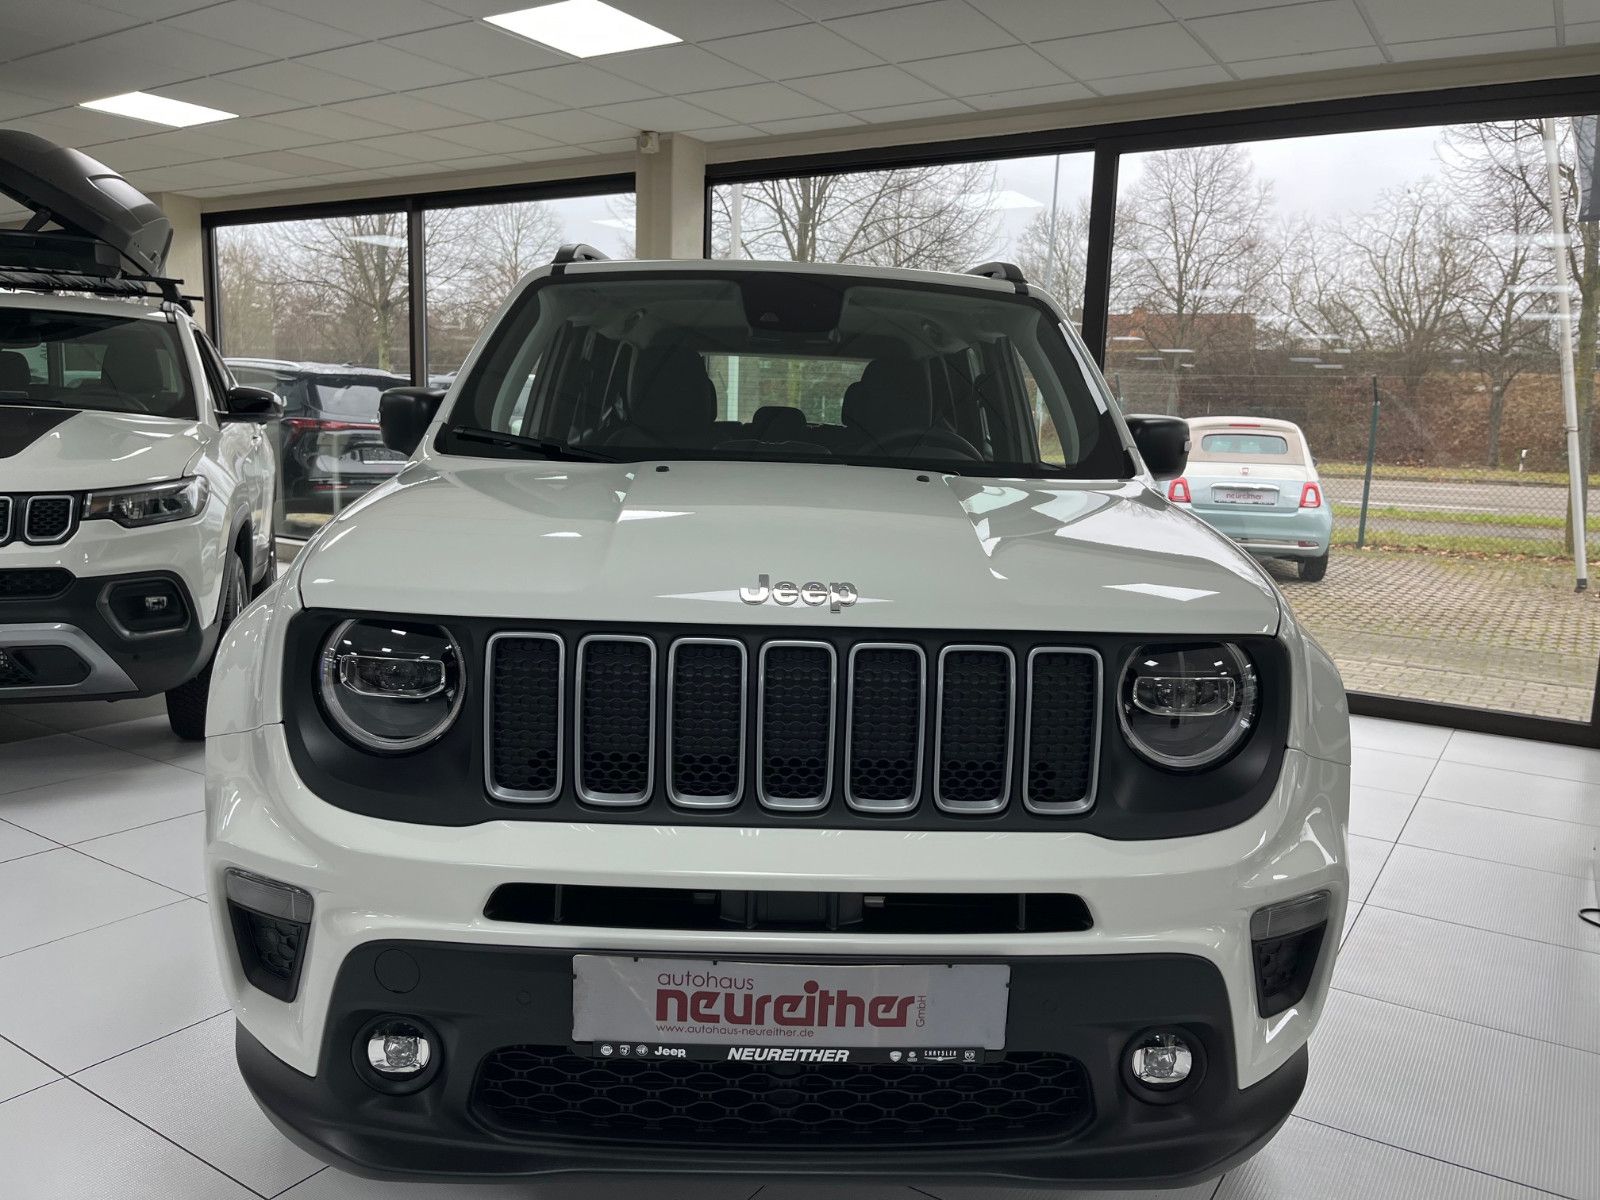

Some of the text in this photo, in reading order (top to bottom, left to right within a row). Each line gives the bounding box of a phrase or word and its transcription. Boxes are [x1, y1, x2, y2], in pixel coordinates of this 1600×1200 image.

[739, 573, 858, 614] Jeep
[657, 971, 755, 990] autohaus
[656, 980, 915, 1027] neureither
[915, 995, 927, 1027] GmbH
[656, 1024, 815, 1038] www.autohaus-neureither.de
[654, 1045, 687, 1058] Jeep
[727, 1046, 850, 1063] NEUREITHER
[923, 1049, 957, 1057] CHRYSLER
